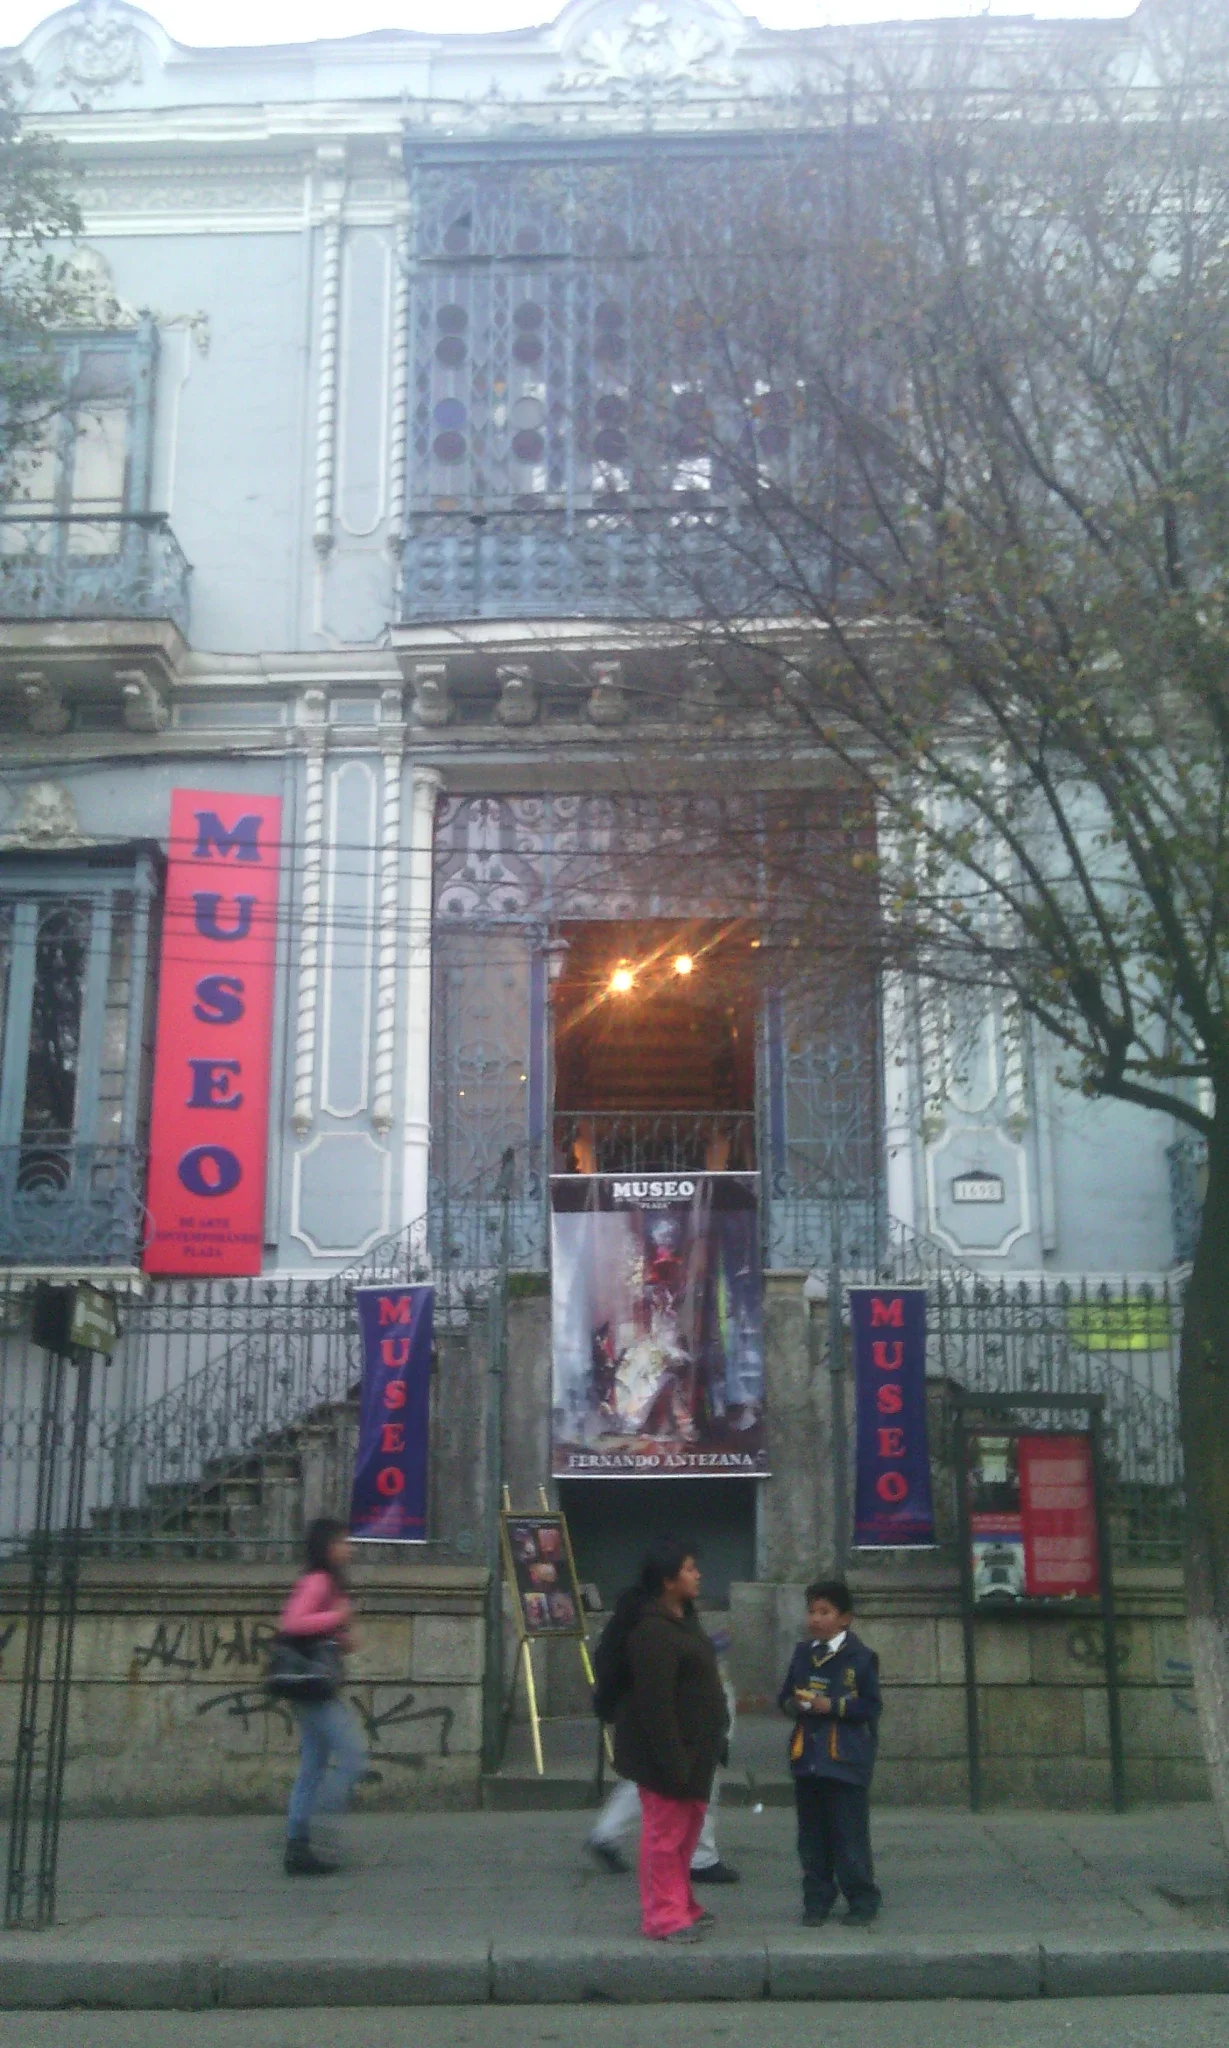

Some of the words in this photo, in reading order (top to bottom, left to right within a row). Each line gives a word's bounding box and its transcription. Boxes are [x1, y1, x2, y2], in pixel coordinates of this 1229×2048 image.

[178, 811, 262, 1196] MUSEO
[613, 1181, 695, 1197] MUSEO
[377, 1296, 412, 1496] MUSEO
[569, 1454, 660, 1467] FERNANDO
[664, 1453, 752, 1466] ANTEZANA
[870, 1298, 909, 1502] MUSEO
